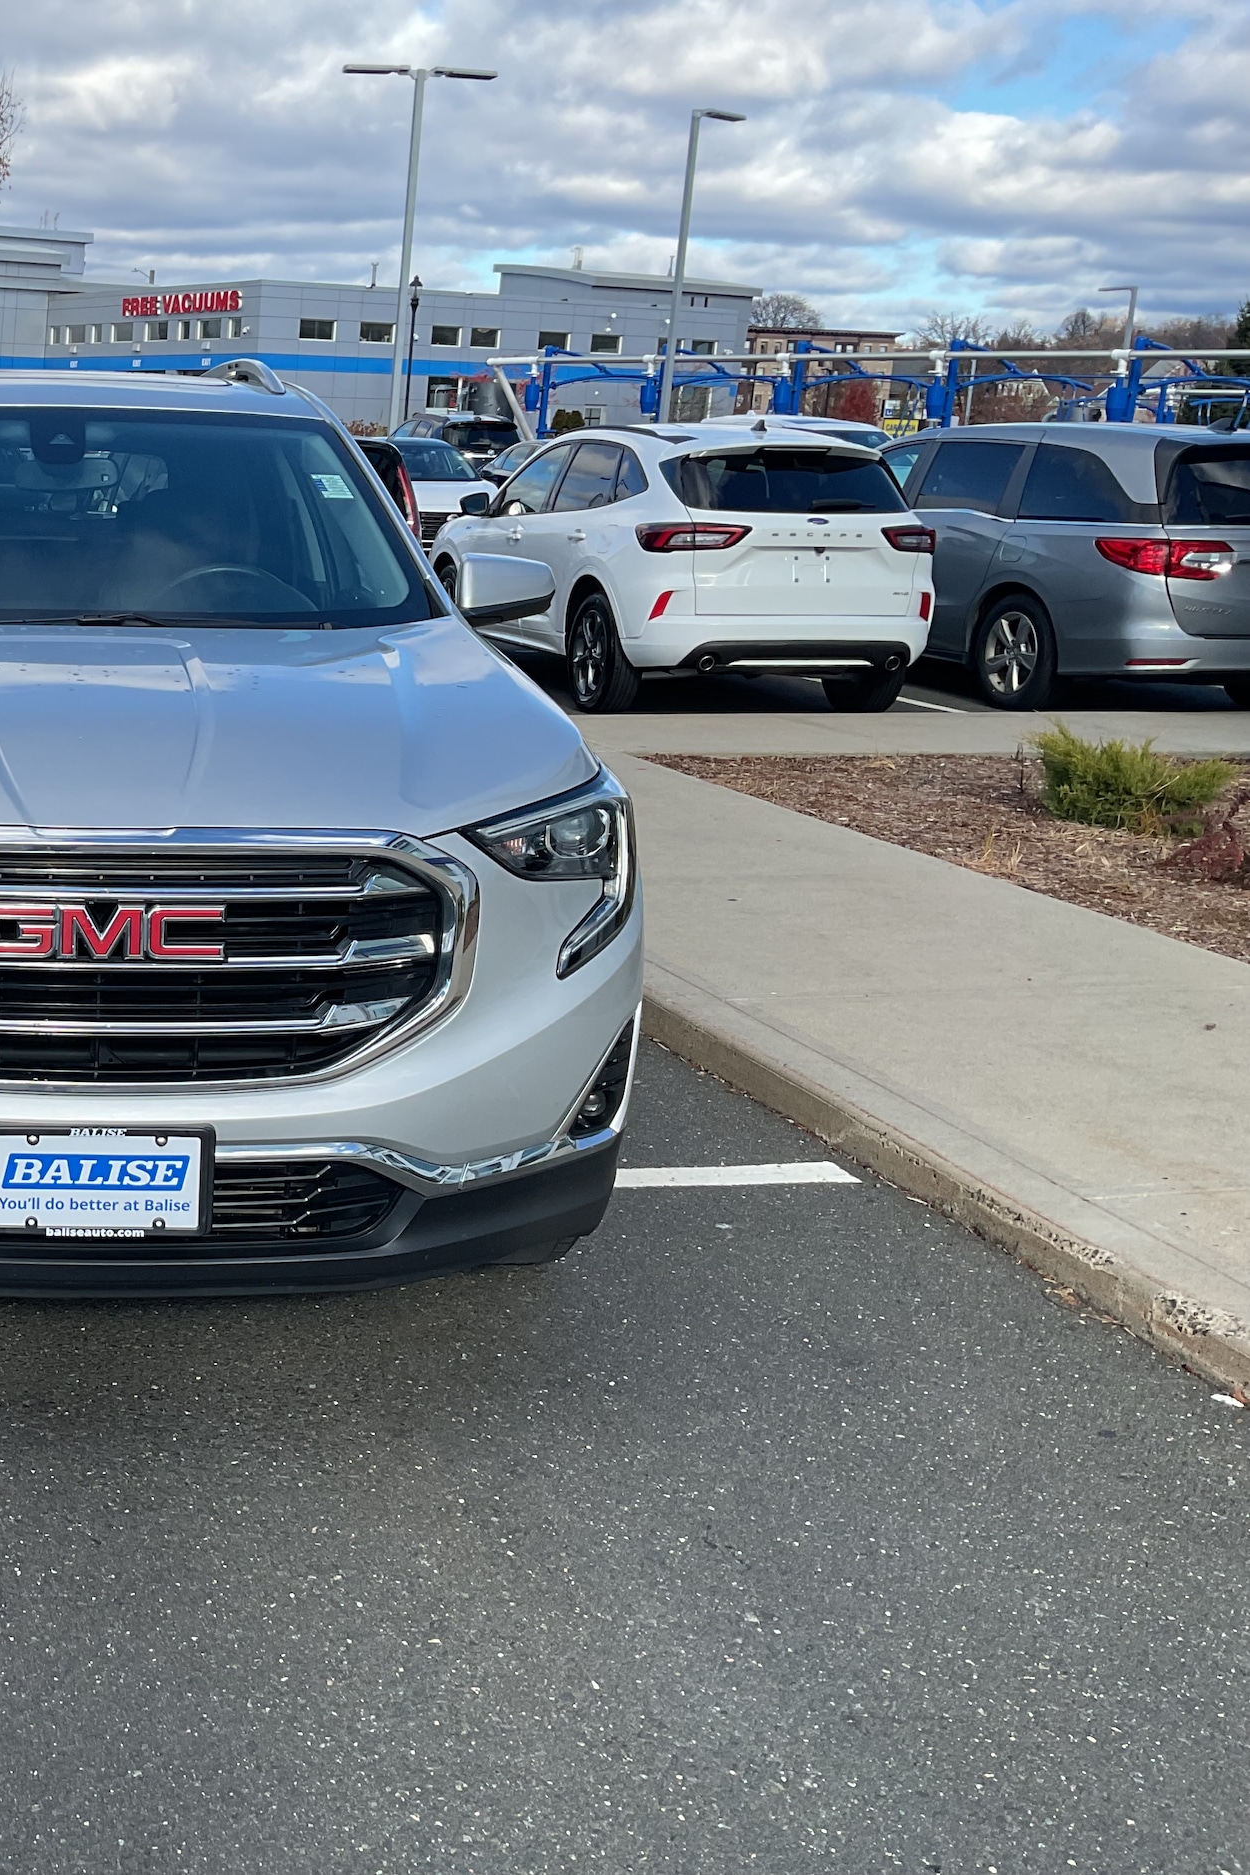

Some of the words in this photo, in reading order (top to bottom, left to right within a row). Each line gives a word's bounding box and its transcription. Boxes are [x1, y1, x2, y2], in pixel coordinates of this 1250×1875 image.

[122, 297, 161, 317] FREE
[162, 290, 243, 315] VACUUMS
[69, 1128, 127, 1137] BALISE
[8, 1158, 183, 1187] BALISE
[0, 1197, 40, 1210] You'll
[45, 1198, 65, 1210] do
[69, 1198, 119, 1211] better
[123, 1200, 140, 1212] at
[144, 1199, 190, 1212] Balise
[45, 1228, 145, 1238] baliseauto.com
